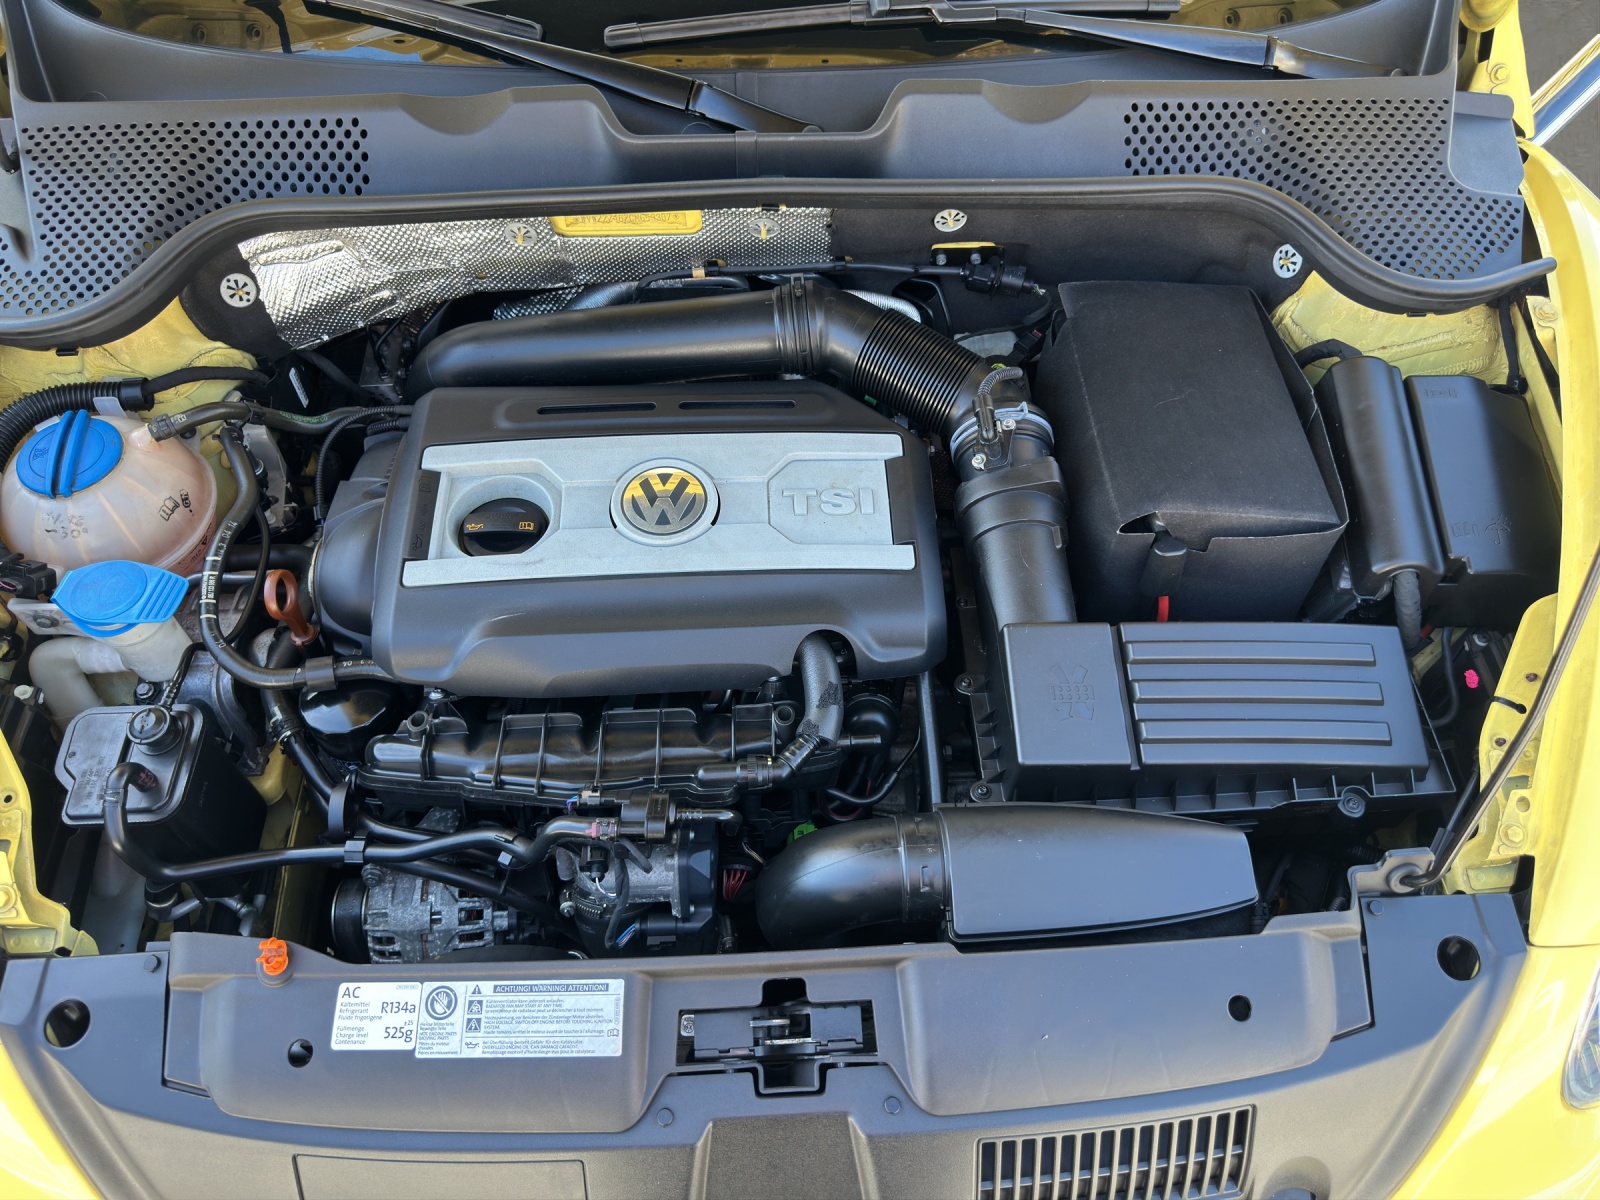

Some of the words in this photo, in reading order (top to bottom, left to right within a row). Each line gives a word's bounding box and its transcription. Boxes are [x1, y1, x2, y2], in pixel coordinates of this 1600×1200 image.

[782, 487, 876, 516] TSI
[342, 986, 361, 998] AC
[381, 1002, 416, 1014] R134a
[384, 1027, 413, 1042] 525g
